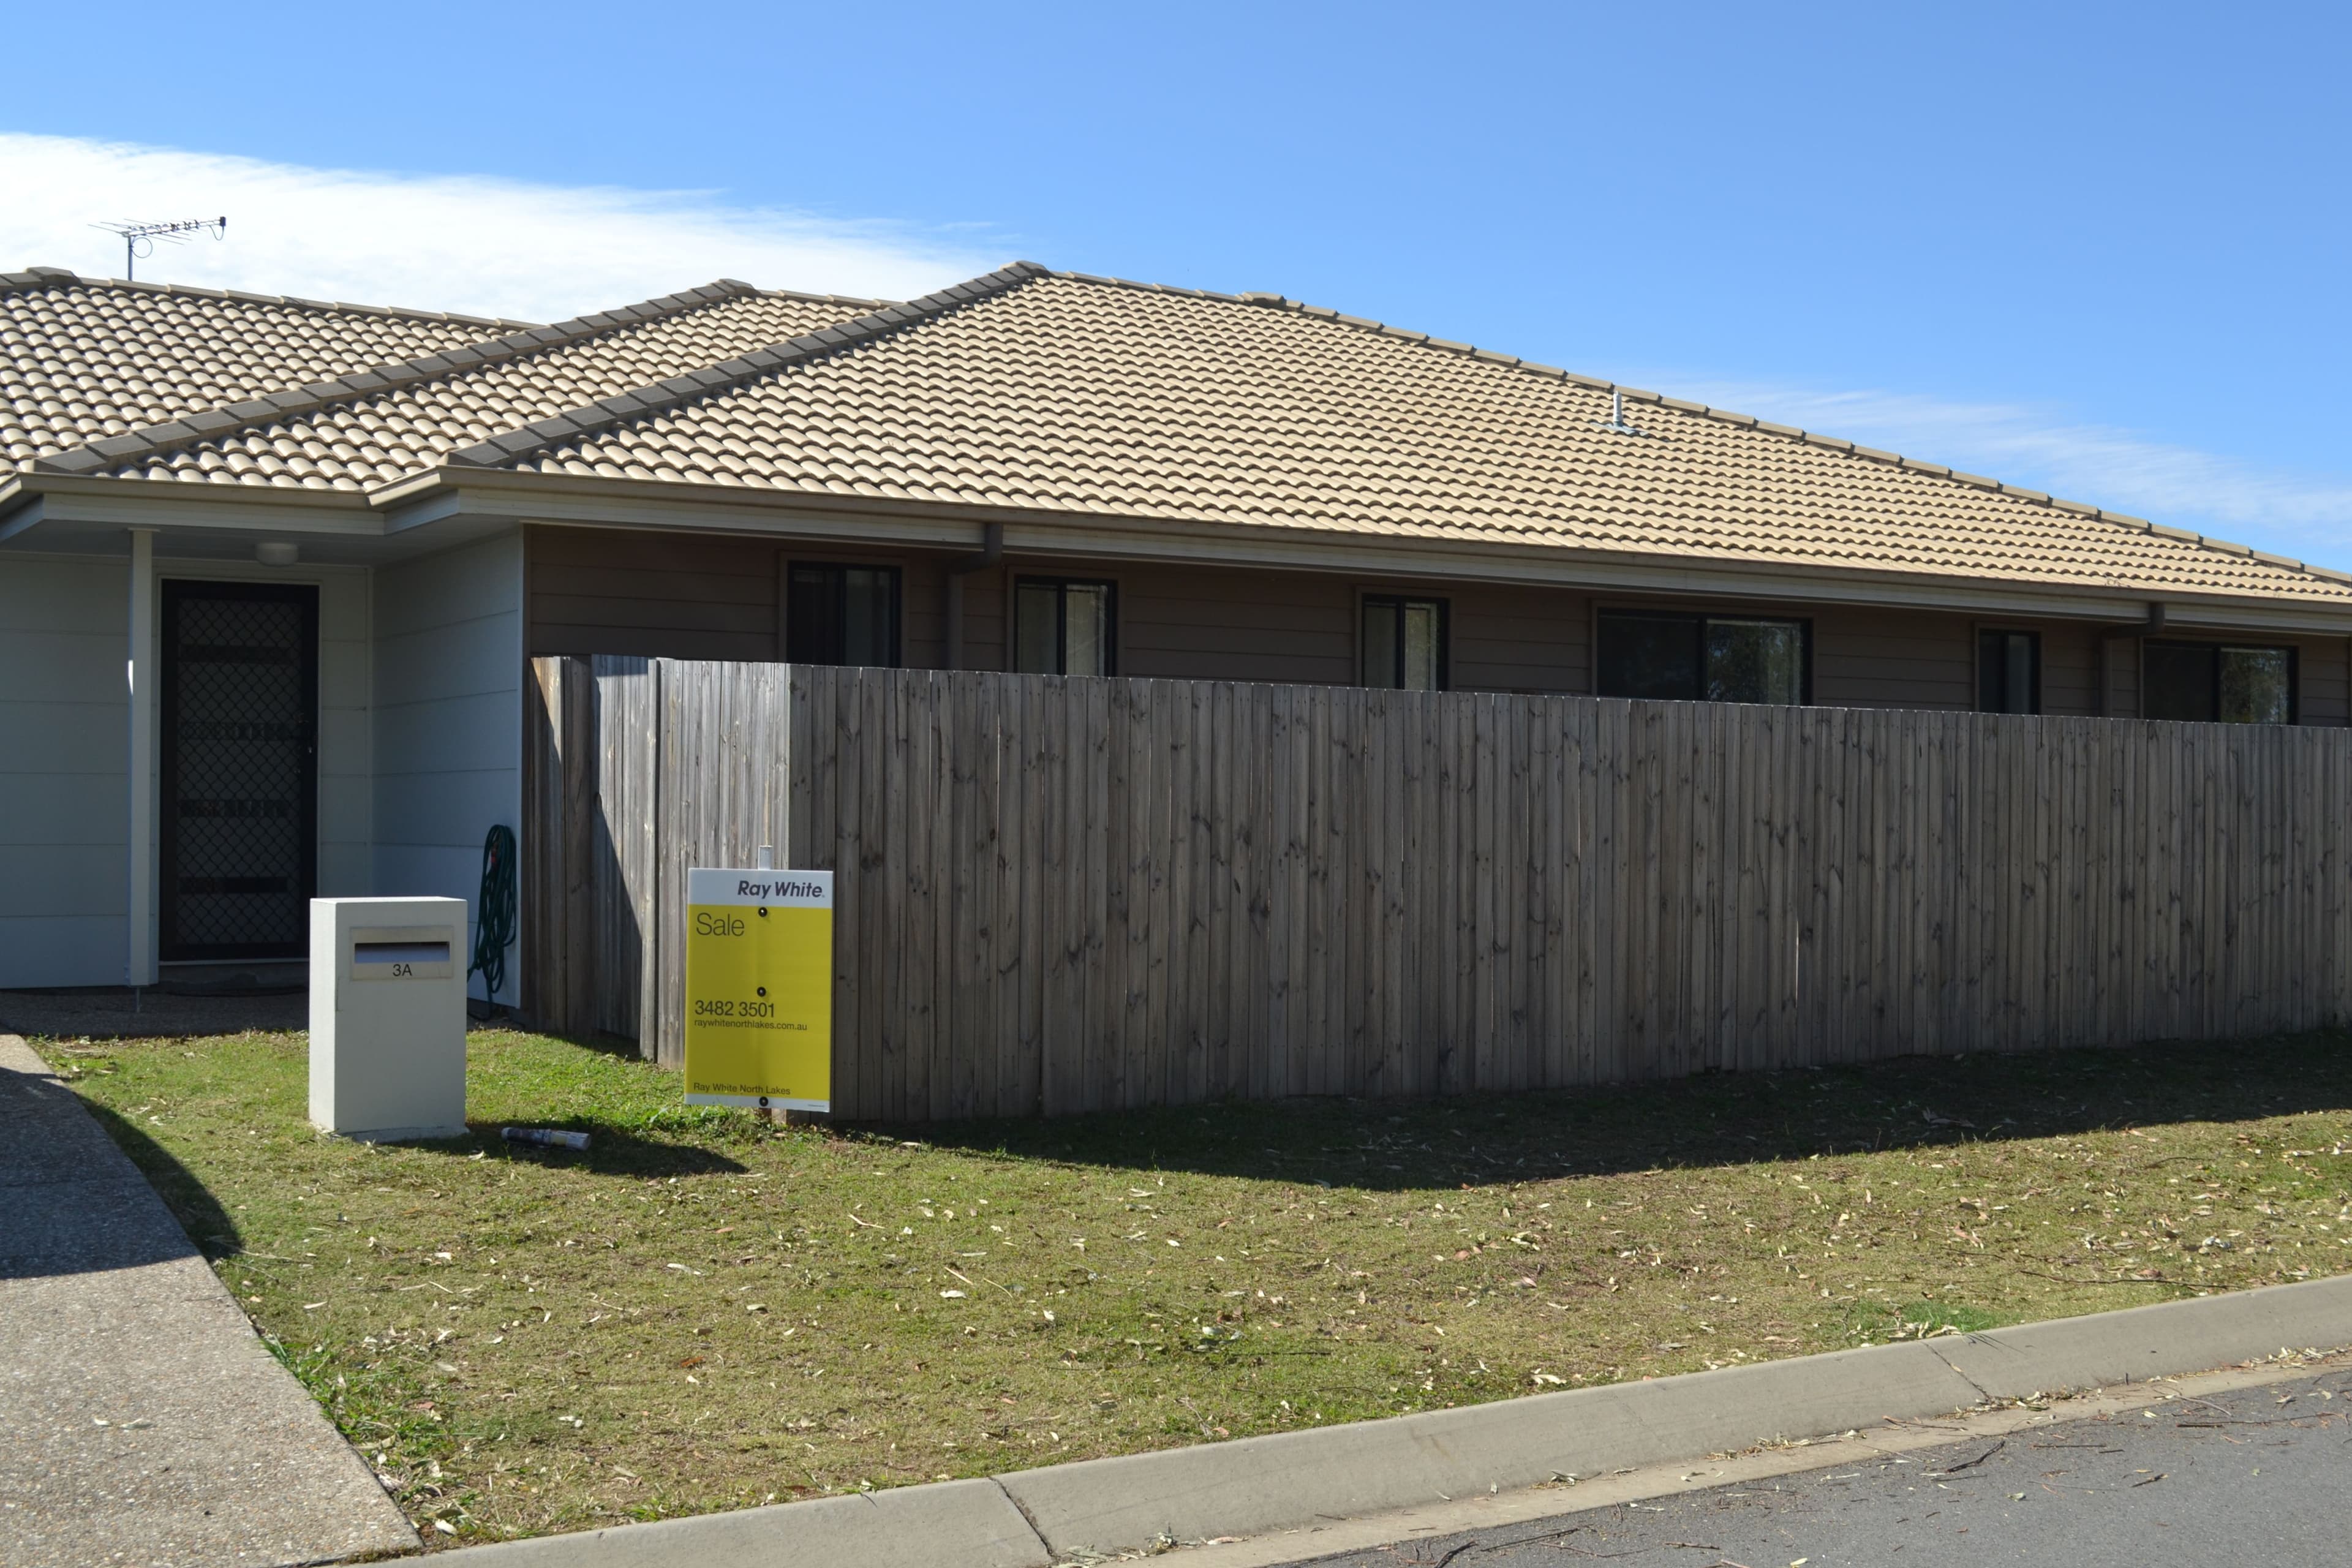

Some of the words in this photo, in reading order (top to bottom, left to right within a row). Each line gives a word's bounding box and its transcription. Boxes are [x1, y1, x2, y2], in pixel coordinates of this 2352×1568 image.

[737, 880, 771, 899] Ray
[775, 881, 823, 897] White
[696, 912, 744, 937] Sale
[393, 963, 412, 976] 3A
[695, 1000, 734, 1016] 3482
[739, 1001, 775, 1017] 3501
[694, 1019, 807, 1031] raywhitenorthlakes.com.au
[693, 1082, 710, 1093] Ray
[712, 1083, 737, 1092] White
[740, 1084, 763, 1093] North
[766, 1086, 791, 1095] Lakes
